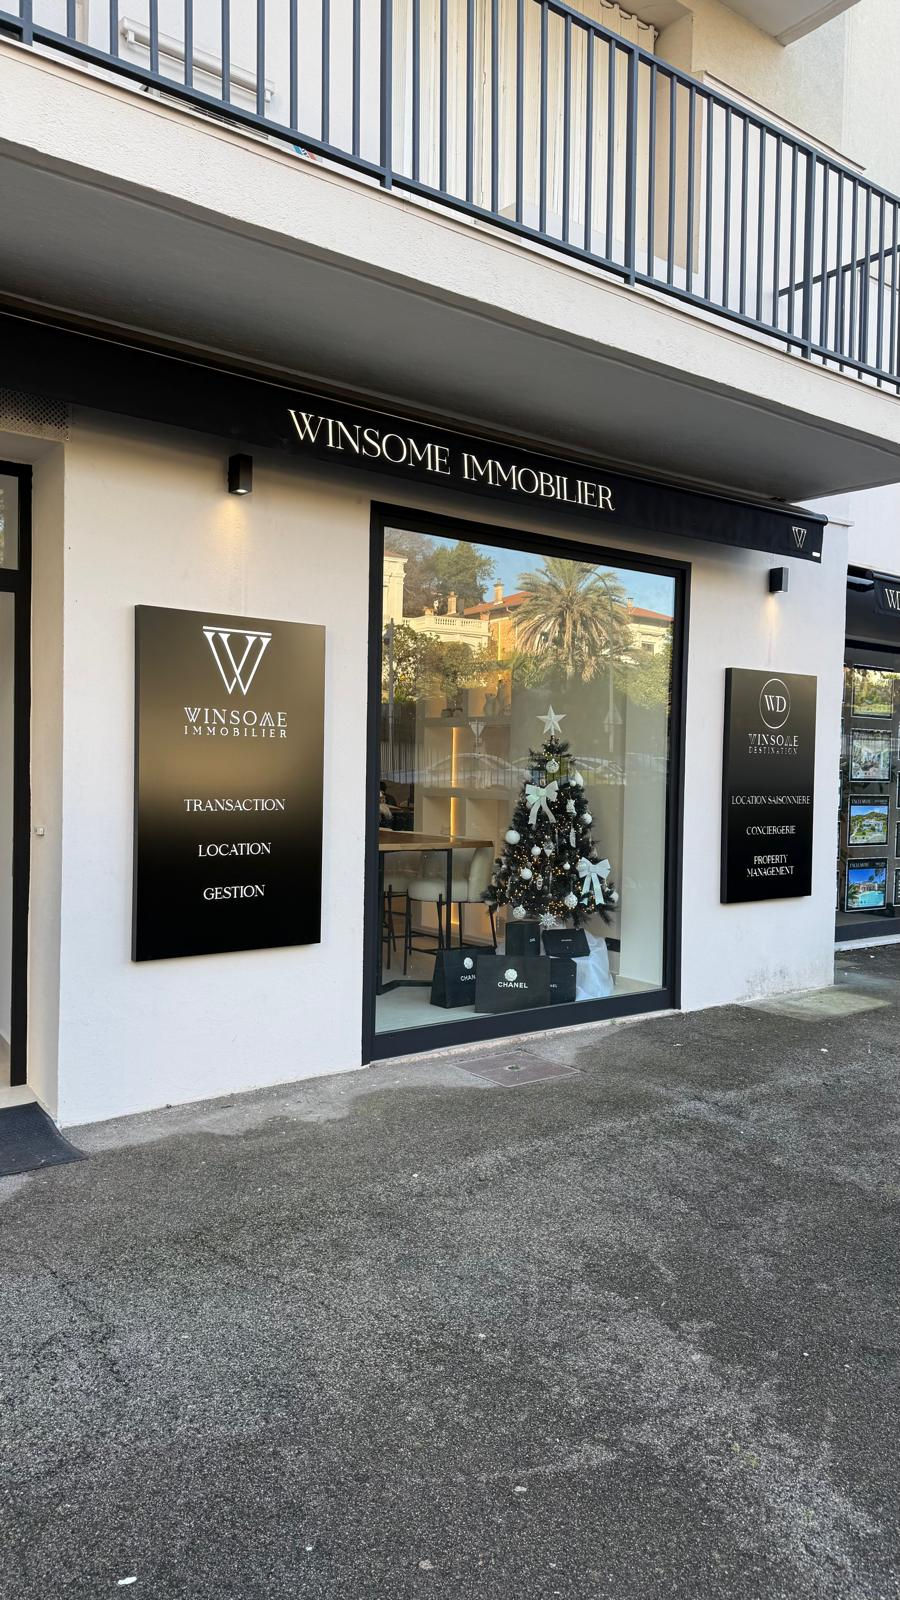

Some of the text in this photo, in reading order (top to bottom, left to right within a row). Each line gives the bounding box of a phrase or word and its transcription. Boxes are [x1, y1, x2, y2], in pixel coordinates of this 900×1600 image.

[288, 409, 615, 511] WINSOME IMMOBILIER
[764, 694, 787, 713] WD
[184, 707, 288, 728] WINSOME
[184, 725, 287, 738] IMMOBILIER
[748, 733, 799, 747] WINSOME
[748, 746, 798, 755] DESTINATION
[184, 798, 286, 812] TRANSACTION
[731, 795, 767, 805] LOCATION
[746, 825, 796, 836] CONCIERGERIE
[198, 842, 271, 857] LOCATION
[753, 854, 788, 865] PROPERTY
[746, 865, 795, 878] MANAGEMENT
[203, 884, 265, 900] GESTION
[497, 981, 529, 989] CHANEL
